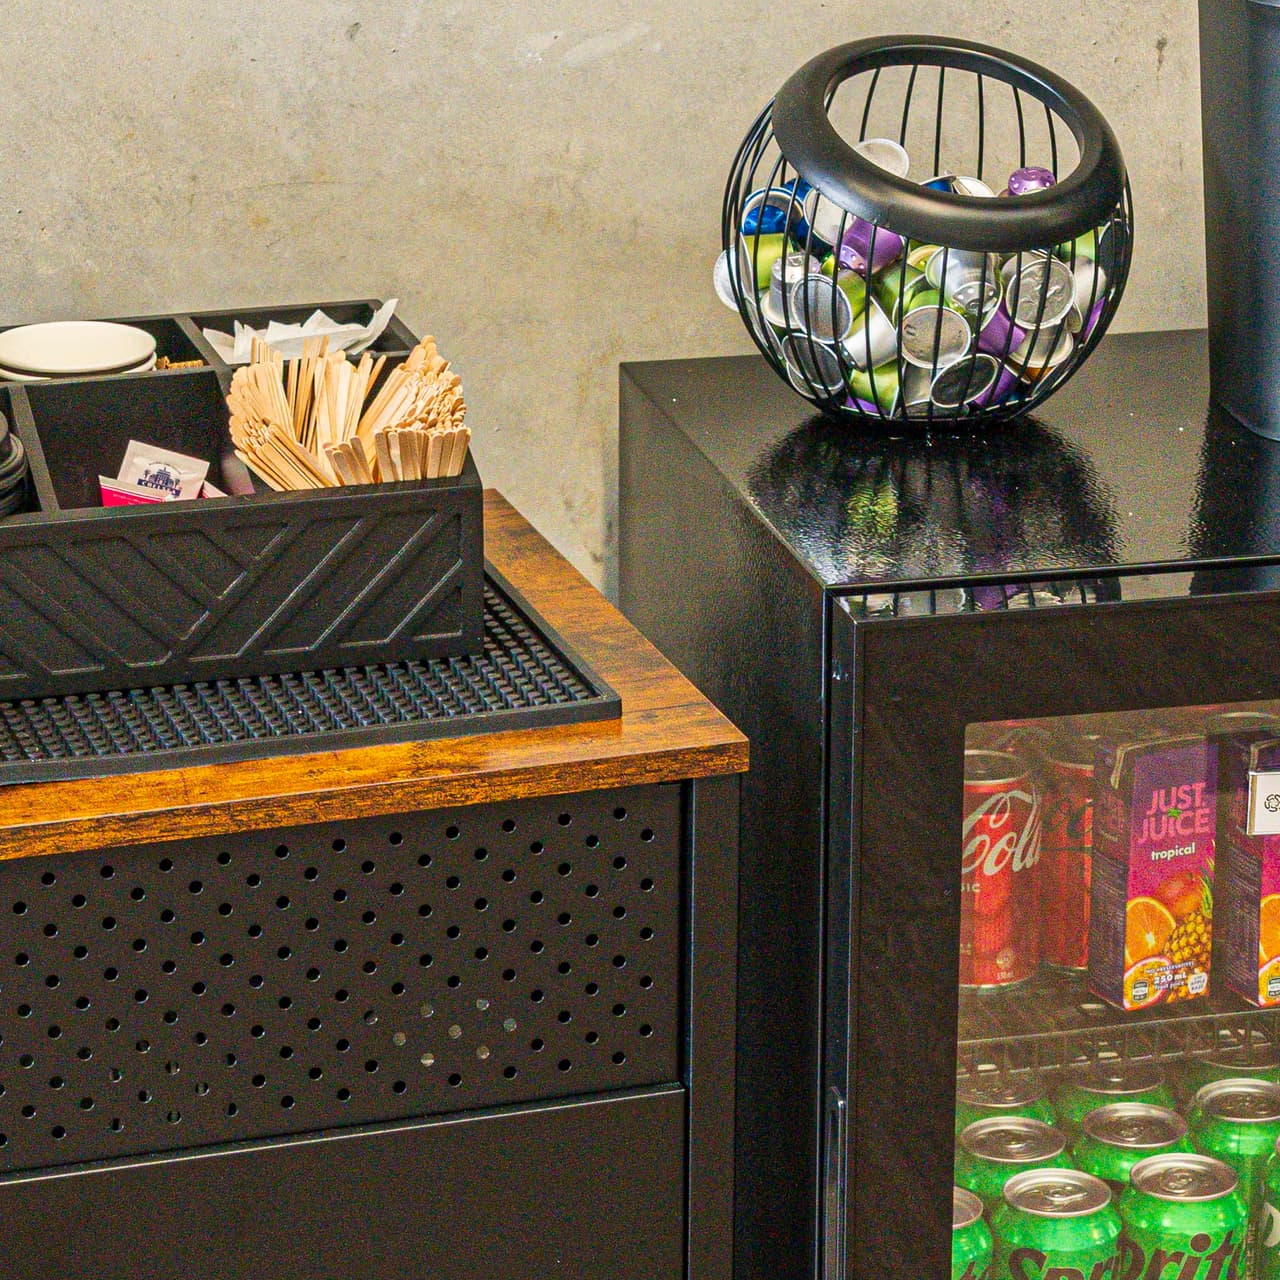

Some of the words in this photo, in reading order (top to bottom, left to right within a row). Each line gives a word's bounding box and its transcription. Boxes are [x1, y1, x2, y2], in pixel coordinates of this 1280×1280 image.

[1147, 782, 1207, 816] JUST
[1137, 808, 1211, 844] JUICE
[1150, 842, 1197, 861] tropical
